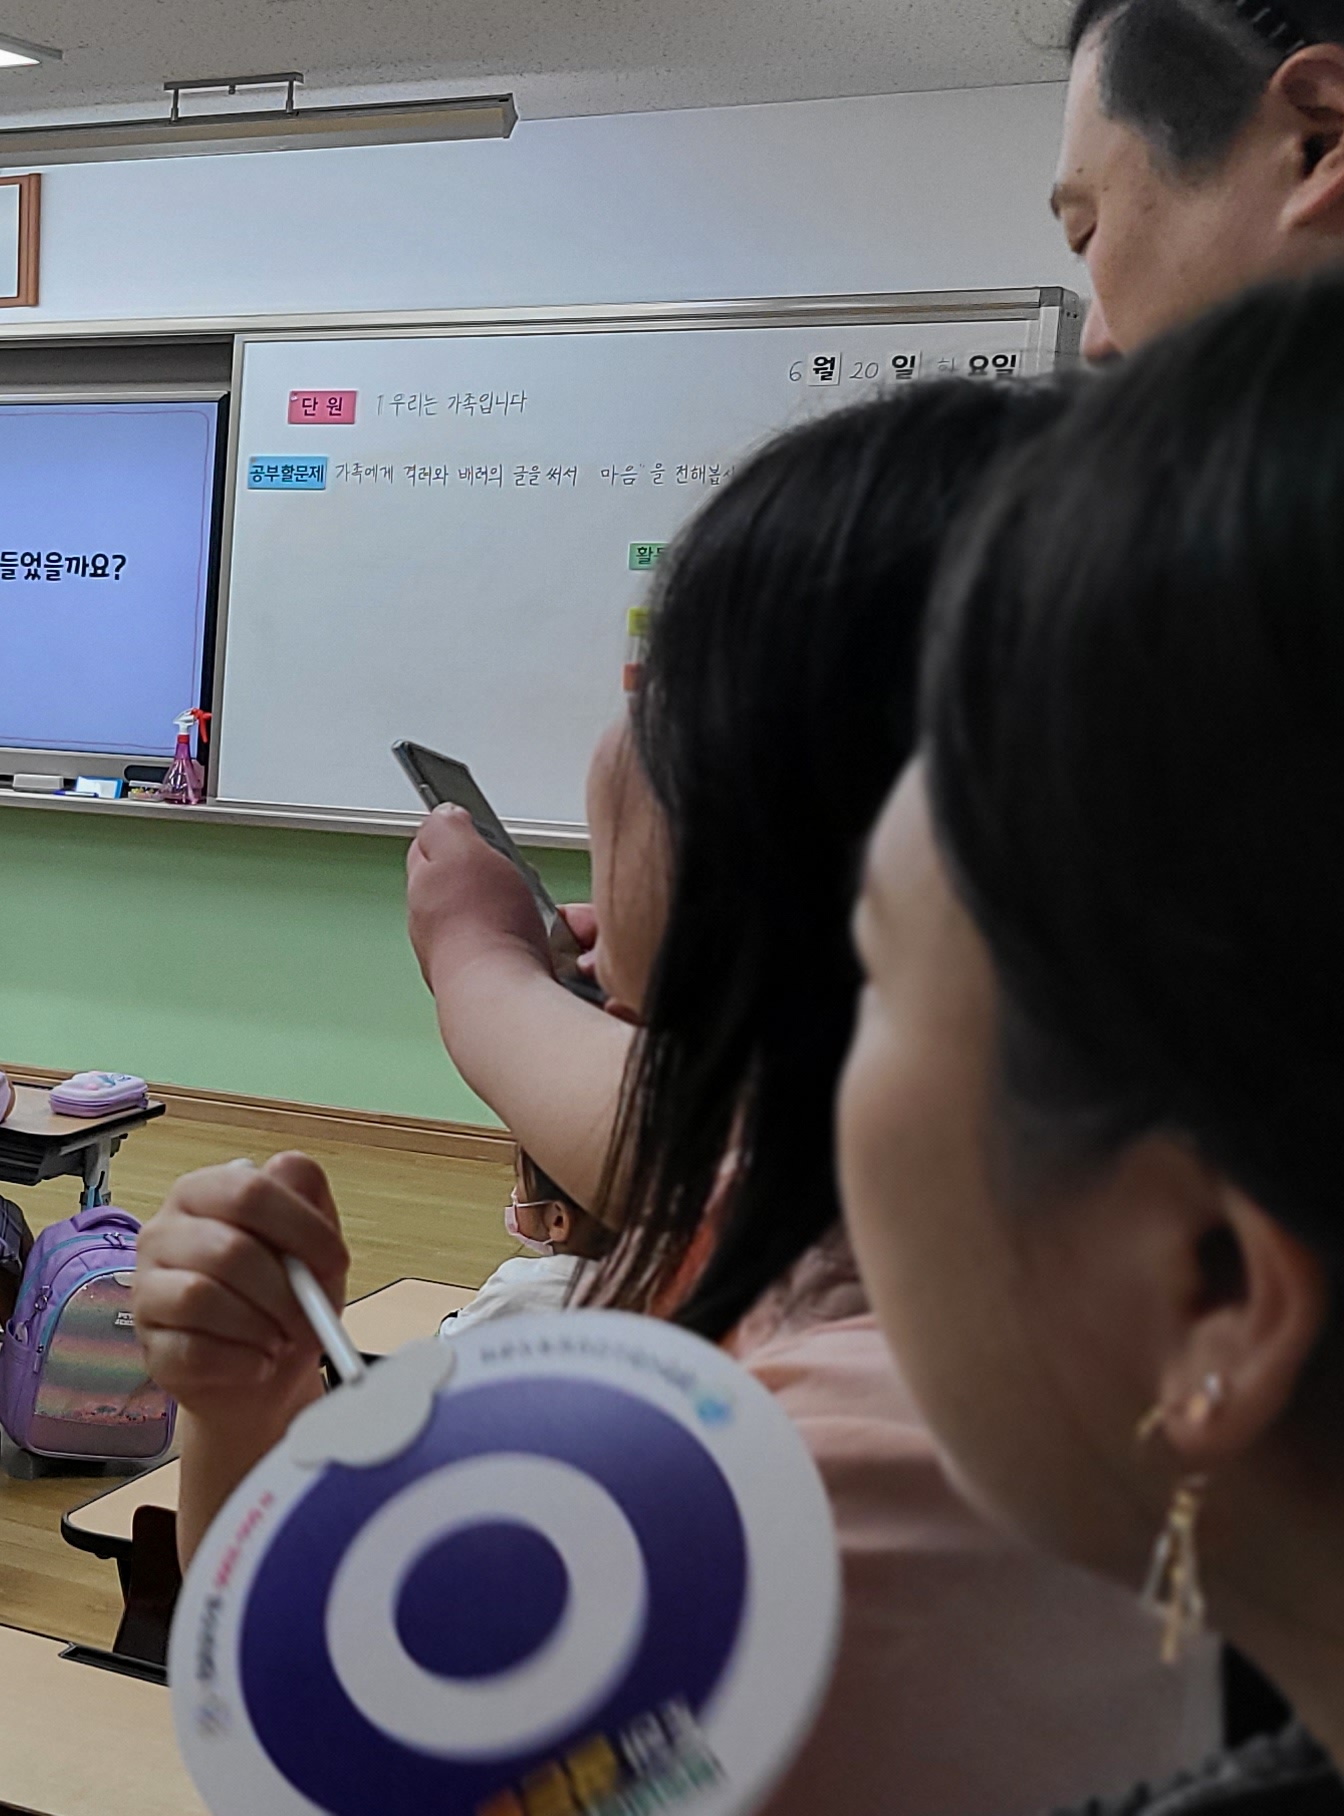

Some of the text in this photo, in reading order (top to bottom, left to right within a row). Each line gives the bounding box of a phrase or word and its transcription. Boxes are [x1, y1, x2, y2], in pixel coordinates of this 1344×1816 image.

[789, 360, 804, 382] 6
[812, 355, 836, 382] 월
[848, 361, 879, 380] 20
[891, 354, 916, 380] 일
[968, 354, 1017, 378] 요일
[389, 393, 438, 417] 우리는
[447, 390, 528, 417] 가족입니다
[250, 465, 324, 483] 공부할문제
[335, 462, 395, 484] 가족에게
[404, 465, 449, 487] 격려와
[458, 464, 503, 488] 배려의
[513, 464, 541, 487] 글을
[546, 463, 579, 487] 써서
[0, 551, 127, 582] 들었을까요?
